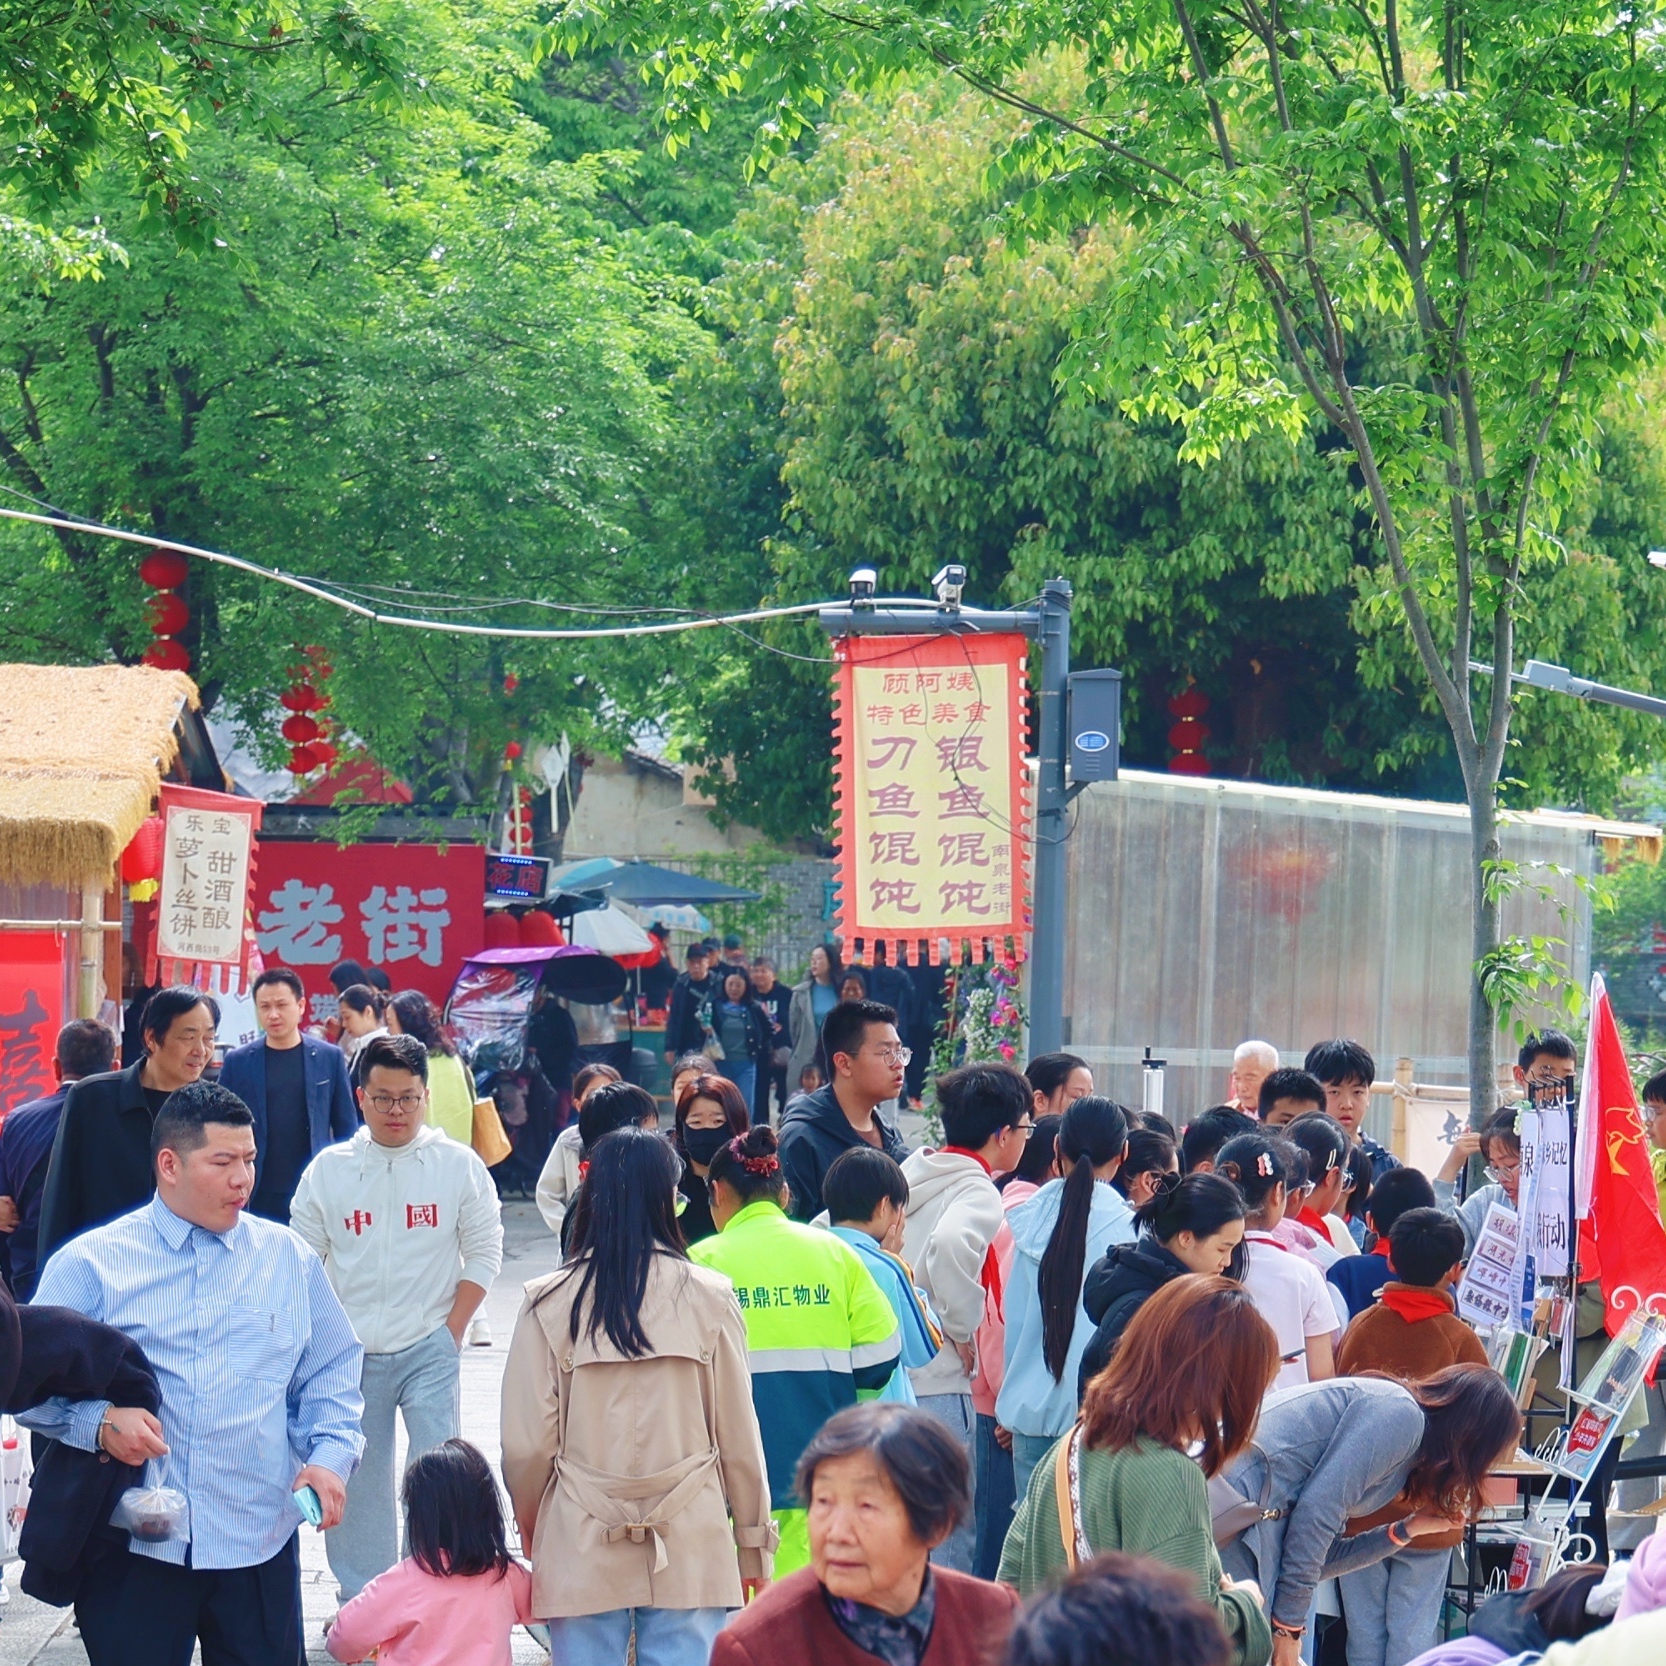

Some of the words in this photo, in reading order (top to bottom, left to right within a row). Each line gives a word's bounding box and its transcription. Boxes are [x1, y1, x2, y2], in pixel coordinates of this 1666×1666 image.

[866, 701, 992, 726] 特色美食
[882, 672, 976, 694] 顾阿姨
[867, 735, 922, 915] 刀鱼馄饨
[936, 735, 992, 916] 银鱼馄饨
[169, 837, 204, 938] 萝卜丝饼
[202, 850, 237, 931] 甜酒酿
[488, 862, 544, 893] 花店
[991, 843, 1012, 915] 南泉老街
[256, 878, 452, 967] 老街
